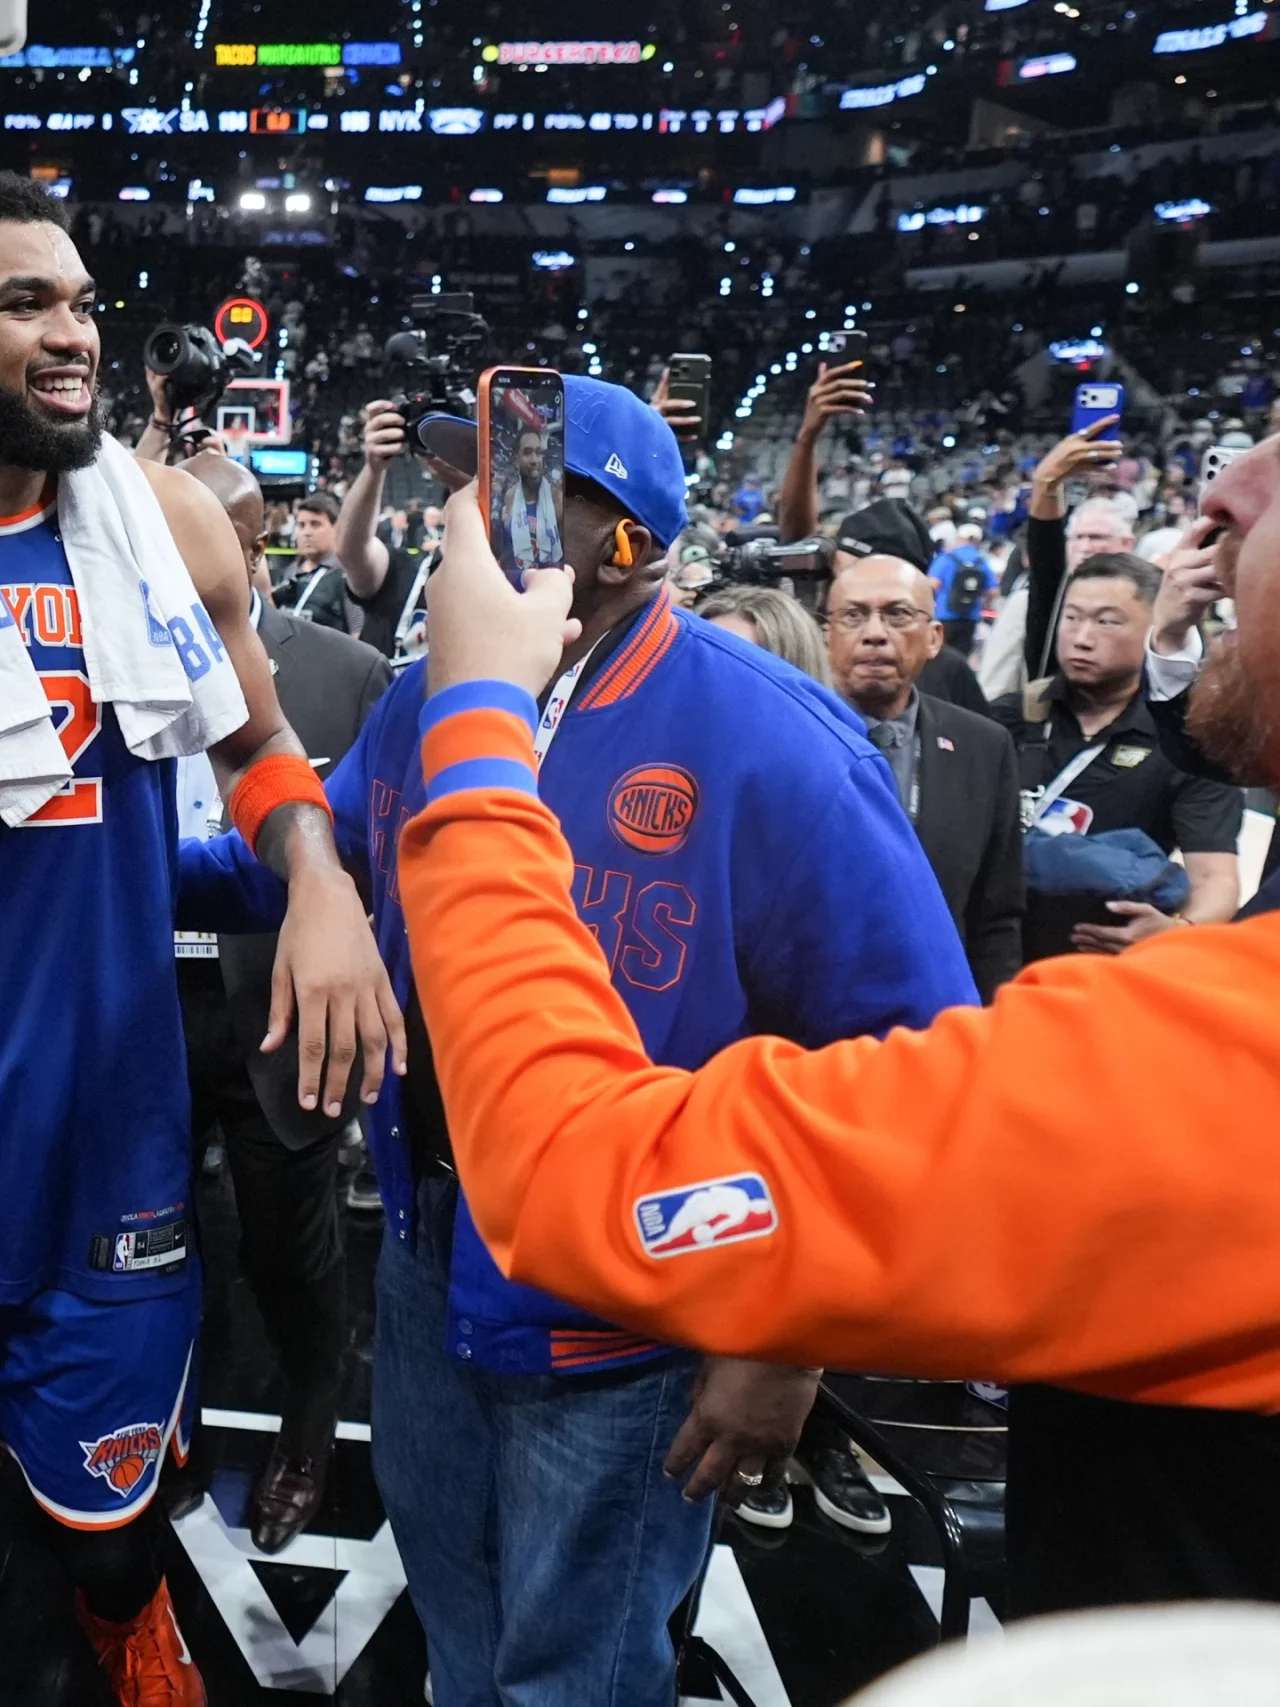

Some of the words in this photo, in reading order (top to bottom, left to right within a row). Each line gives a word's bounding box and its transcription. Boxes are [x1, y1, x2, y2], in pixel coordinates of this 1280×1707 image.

[214, 43, 256, 66] TACOS
[179, 110, 209, 131] SA
[379, 110, 421, 132] NYK
[620, 787, 691, 832] KNICKS
[639, 1203, 667, 1237] NBA
[89, 1426, 162, 1468] KNICKS
